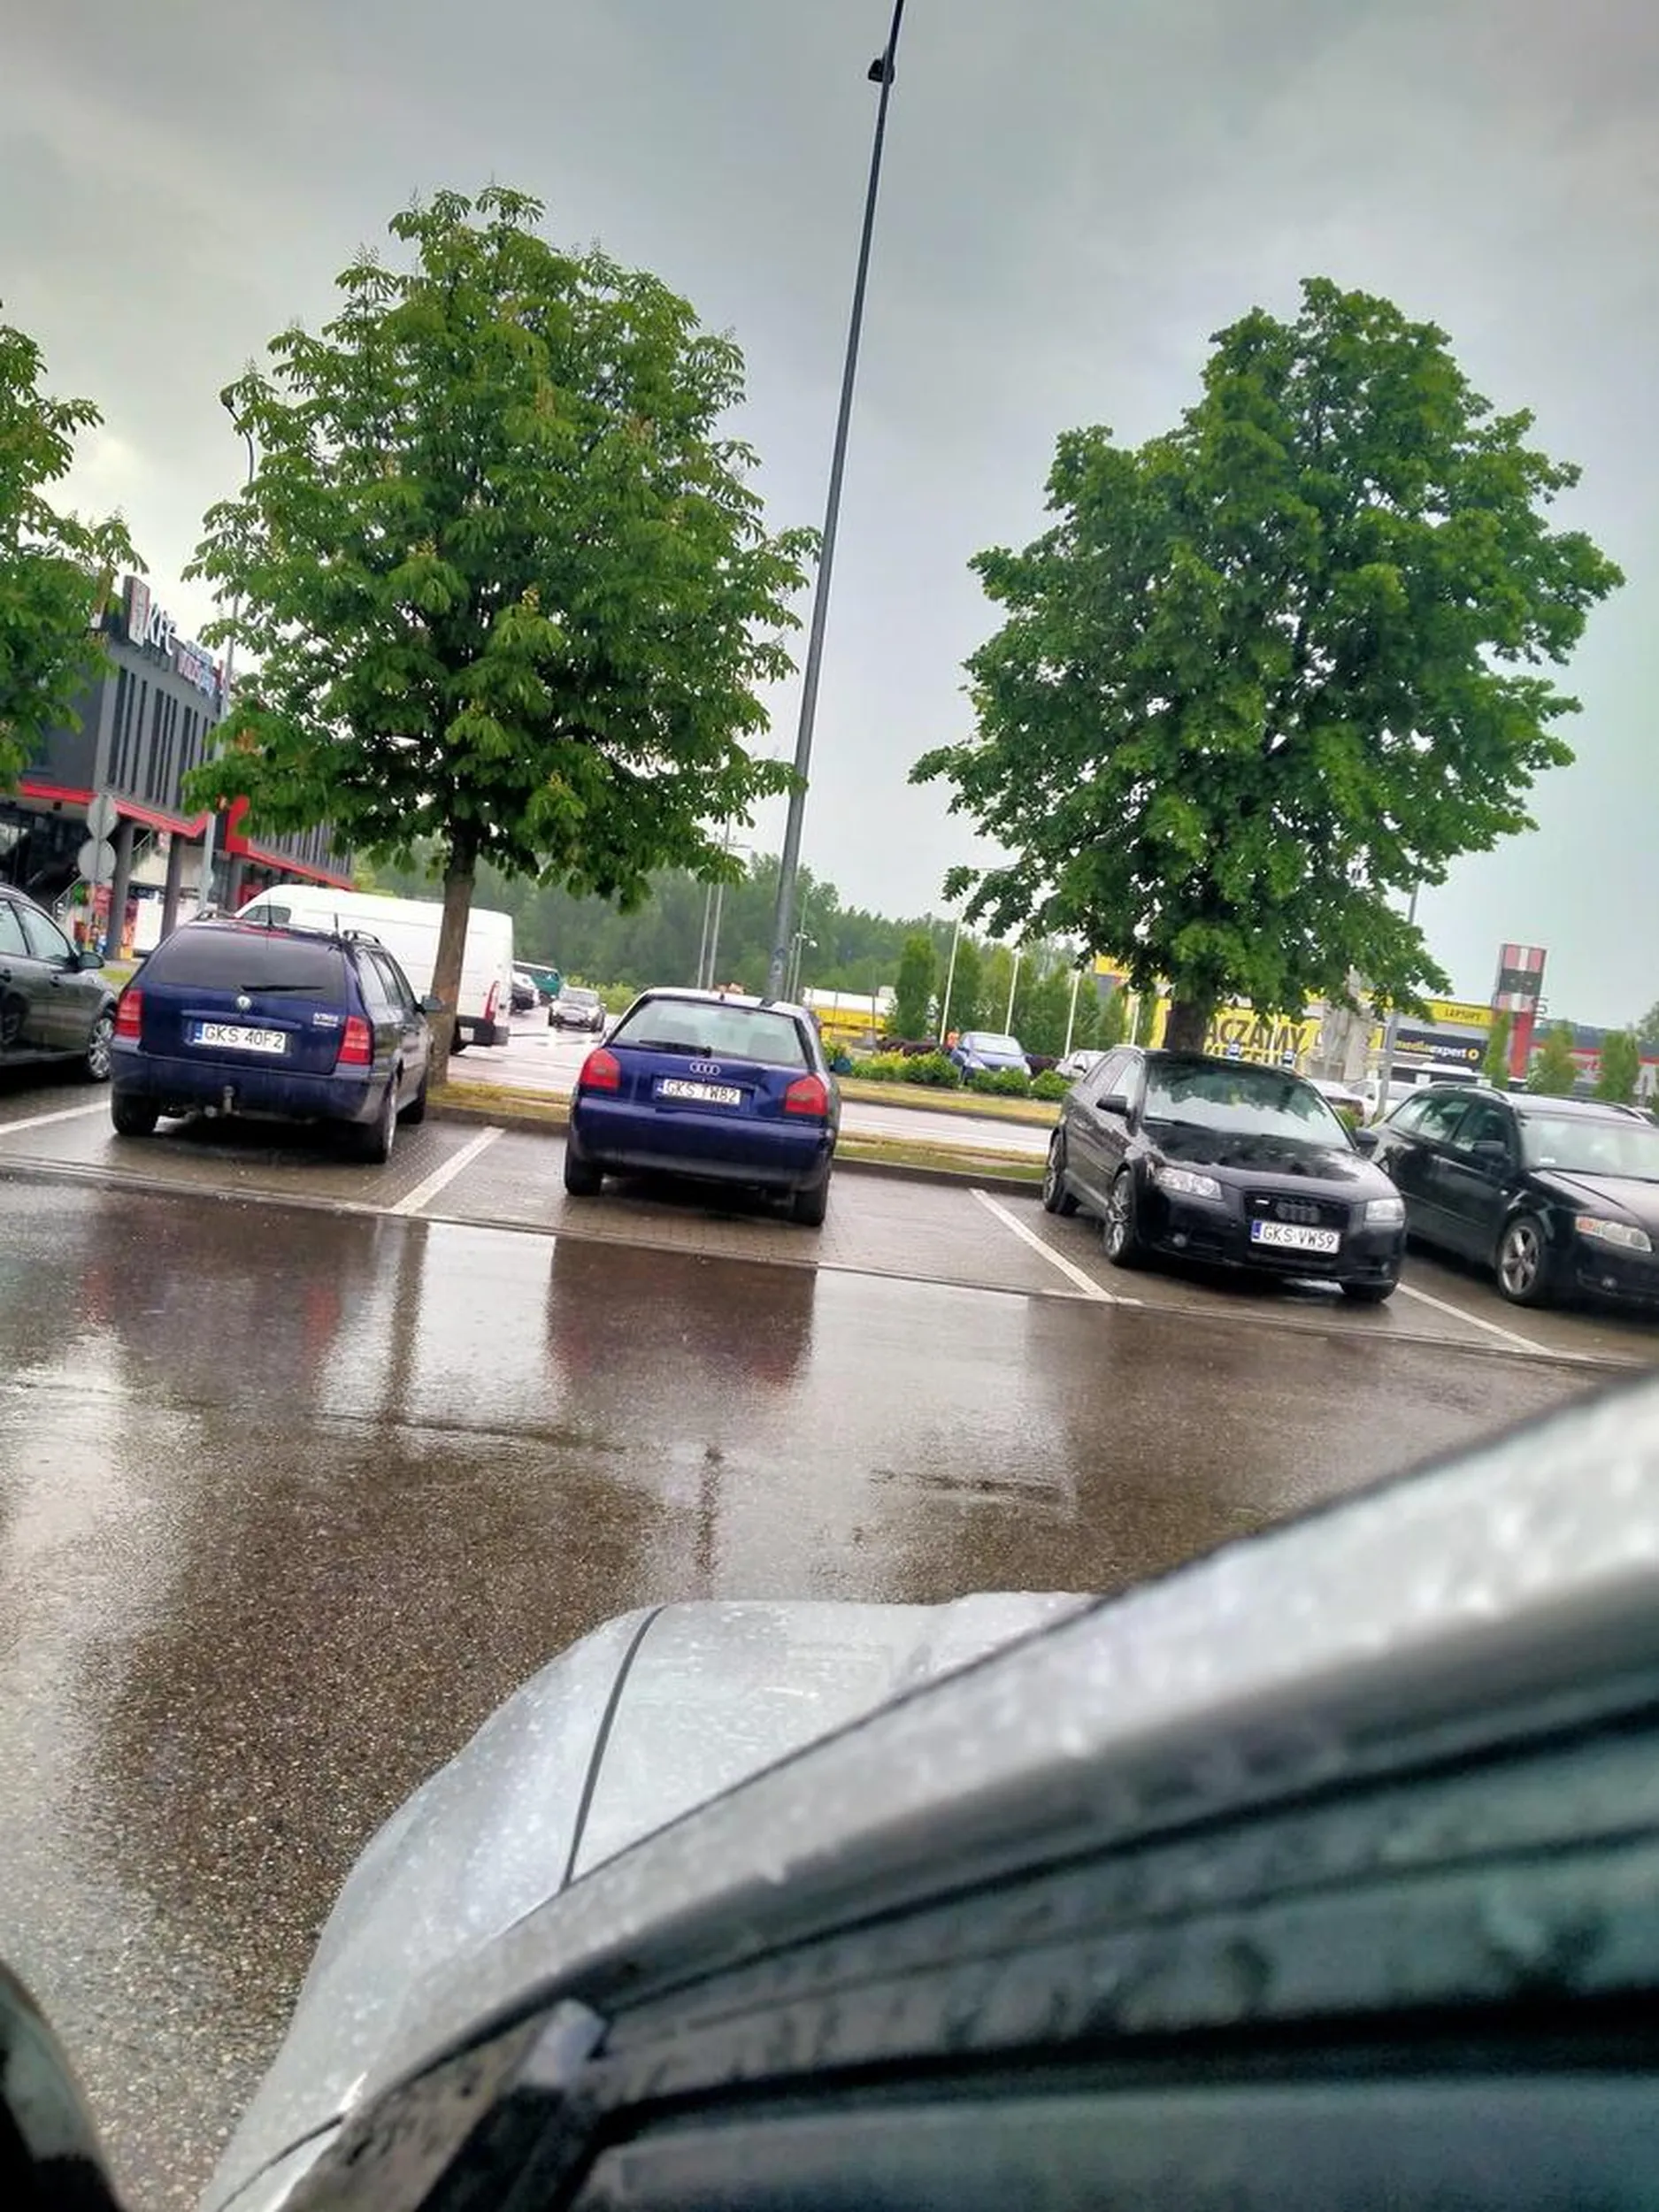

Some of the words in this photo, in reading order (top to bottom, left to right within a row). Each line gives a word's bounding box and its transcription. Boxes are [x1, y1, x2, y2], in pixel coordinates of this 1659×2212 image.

[204, 1024, 239, 1043] GKS
[667, 1080, 695, 1098] GKS
[1263, 1224, 1294, 1243] GKS
